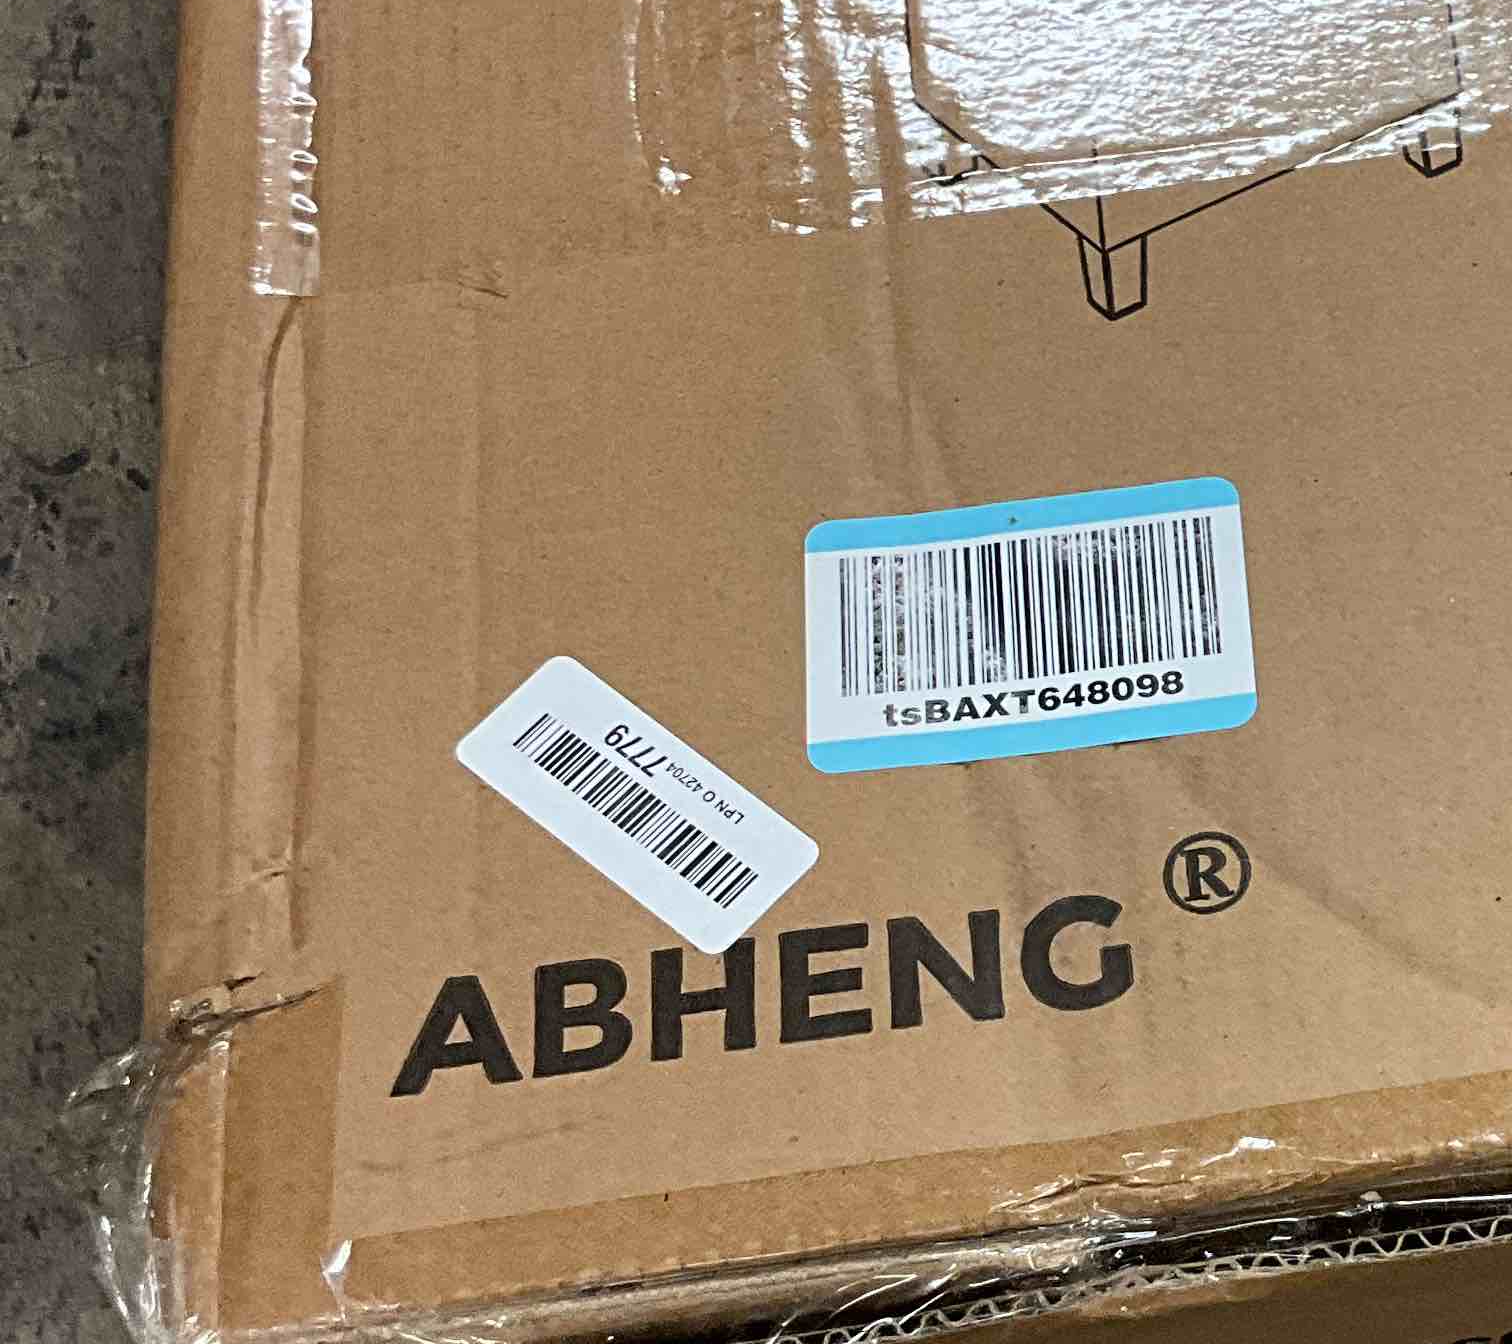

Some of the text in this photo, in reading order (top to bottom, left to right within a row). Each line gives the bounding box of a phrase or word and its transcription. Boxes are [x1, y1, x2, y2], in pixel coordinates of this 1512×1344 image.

[882, 671, 1186, 730] tsBAXT648098
[604, 724, 668, 778] 7779
[665, 762, 704, 793] 42704
[714, 799, 745, 825] LPN
[390, 894, 1134, 1098] ABHENG
